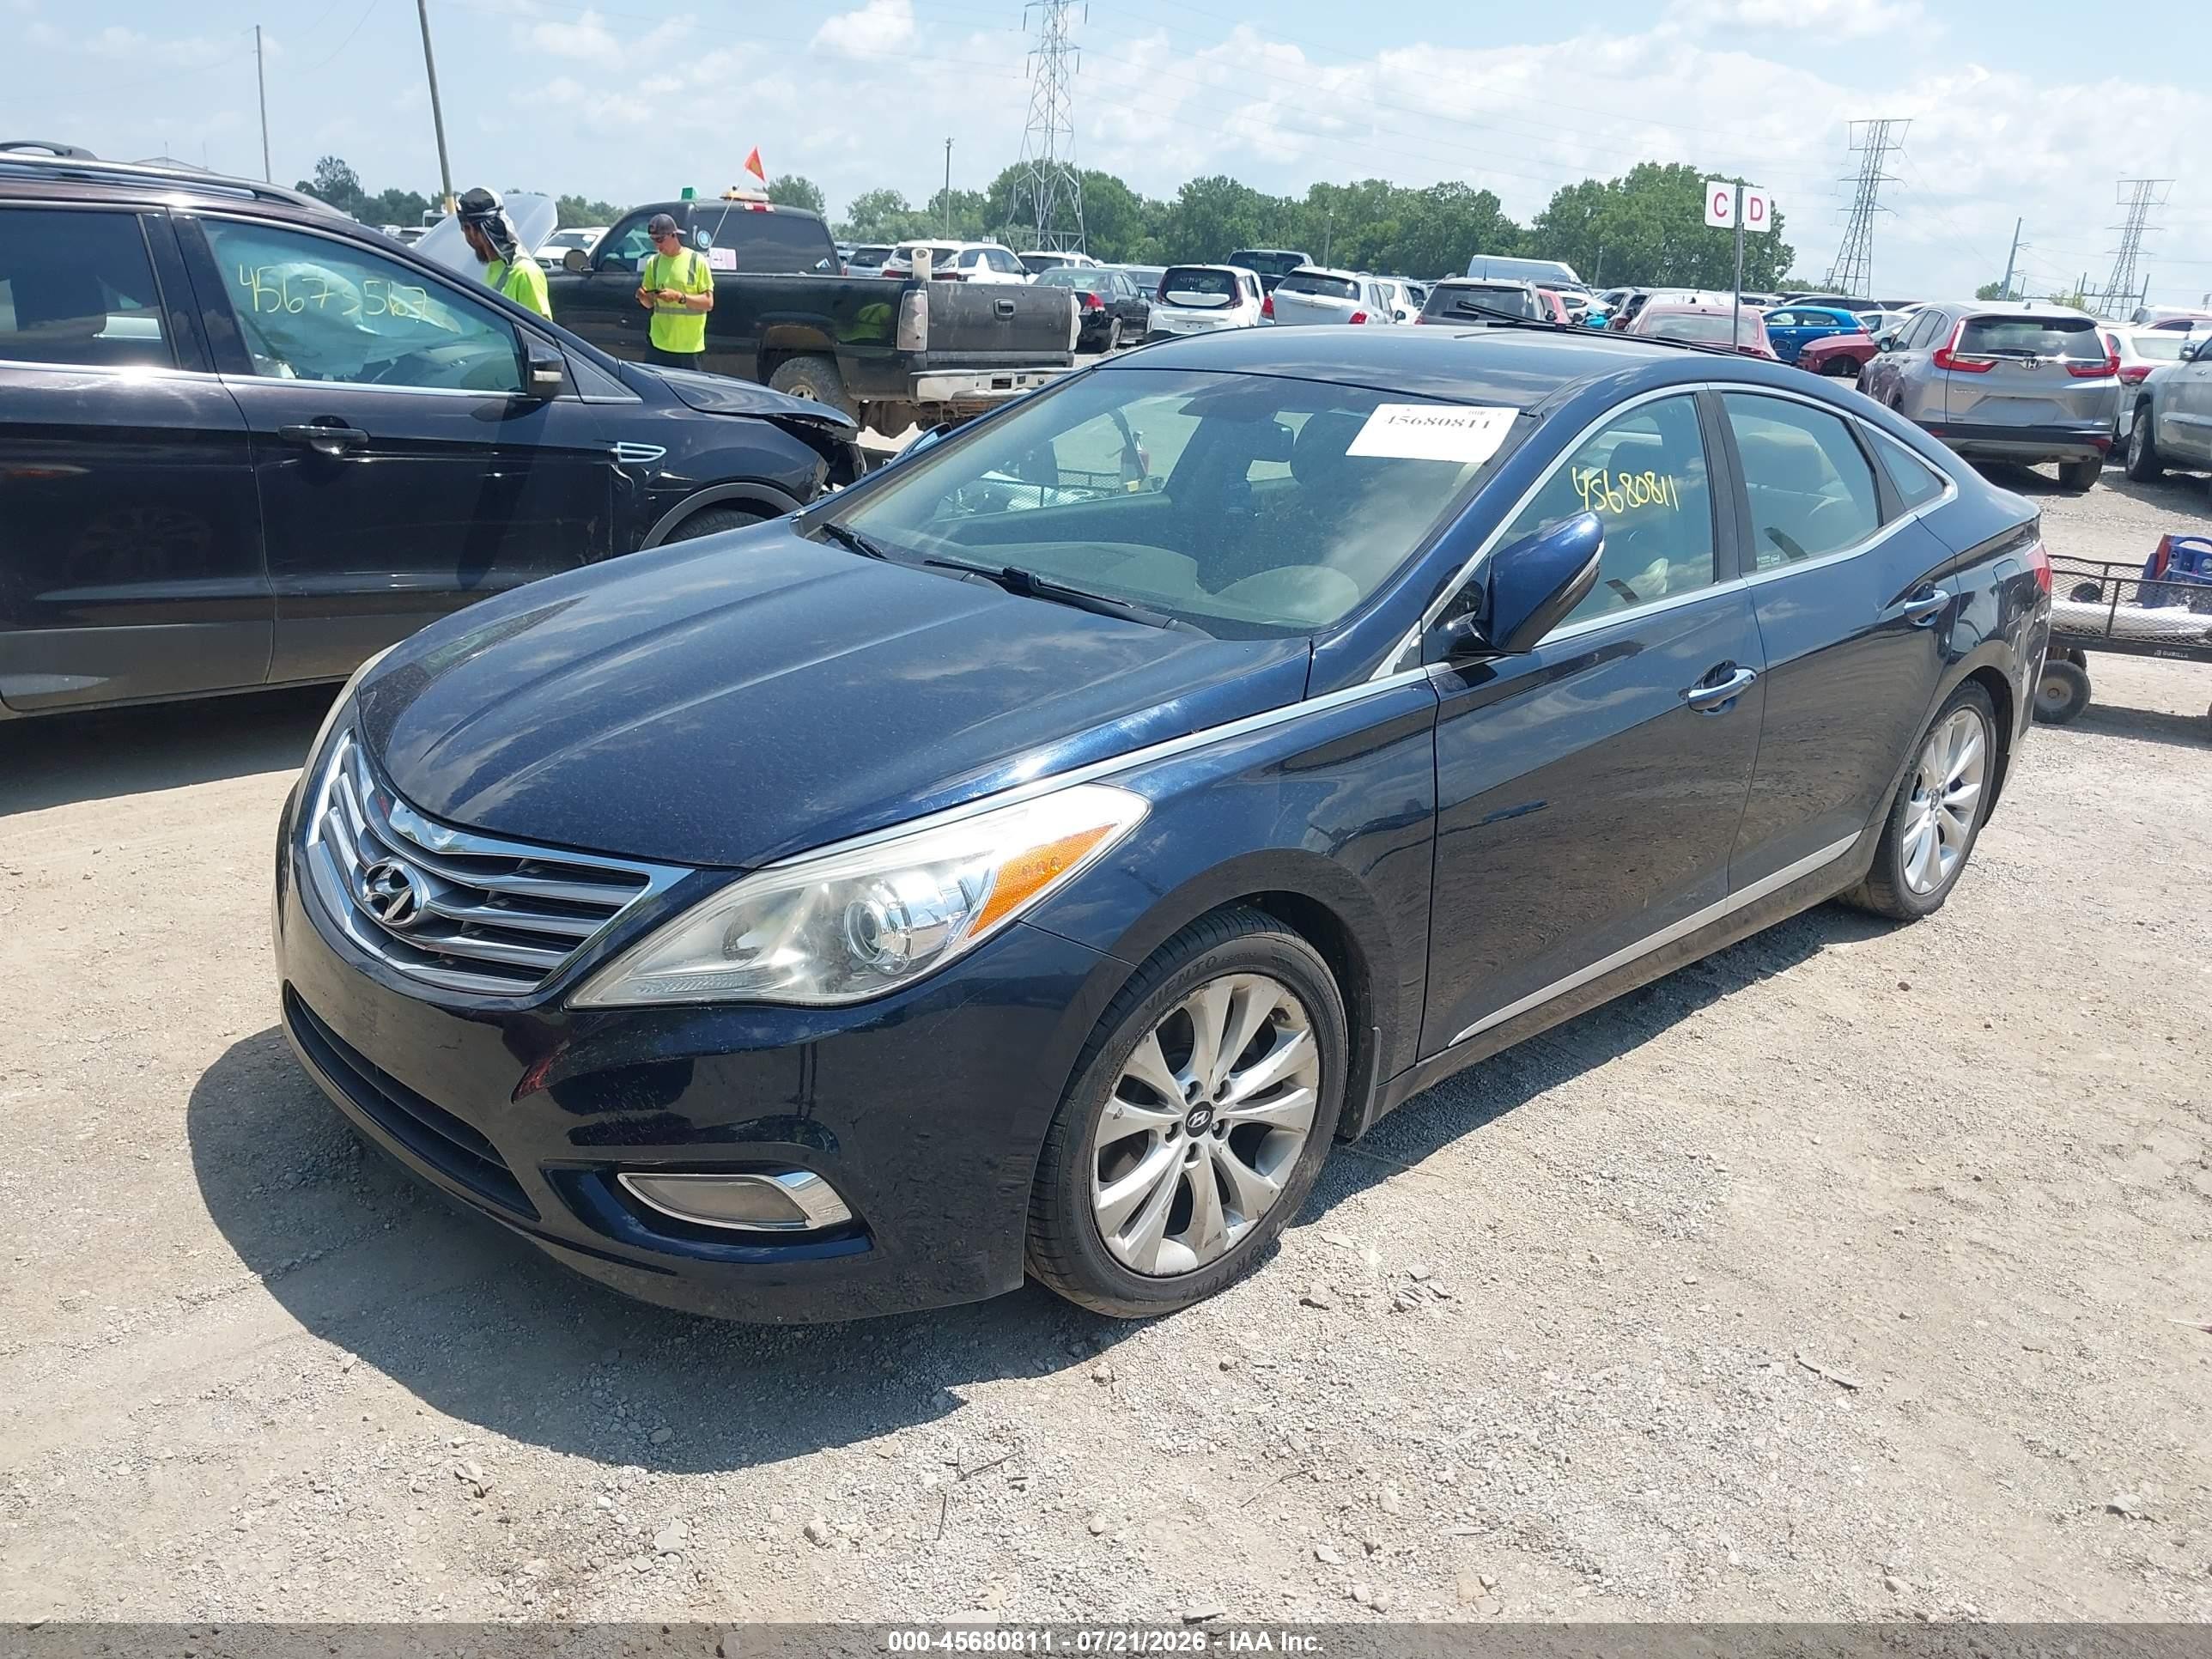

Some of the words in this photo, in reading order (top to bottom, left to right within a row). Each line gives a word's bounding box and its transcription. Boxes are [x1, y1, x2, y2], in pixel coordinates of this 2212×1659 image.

[1714, 192, 1728, 217] C
[1750, 197, 1764, 222] D
[1571, 466, 1680, 514] 45680811
